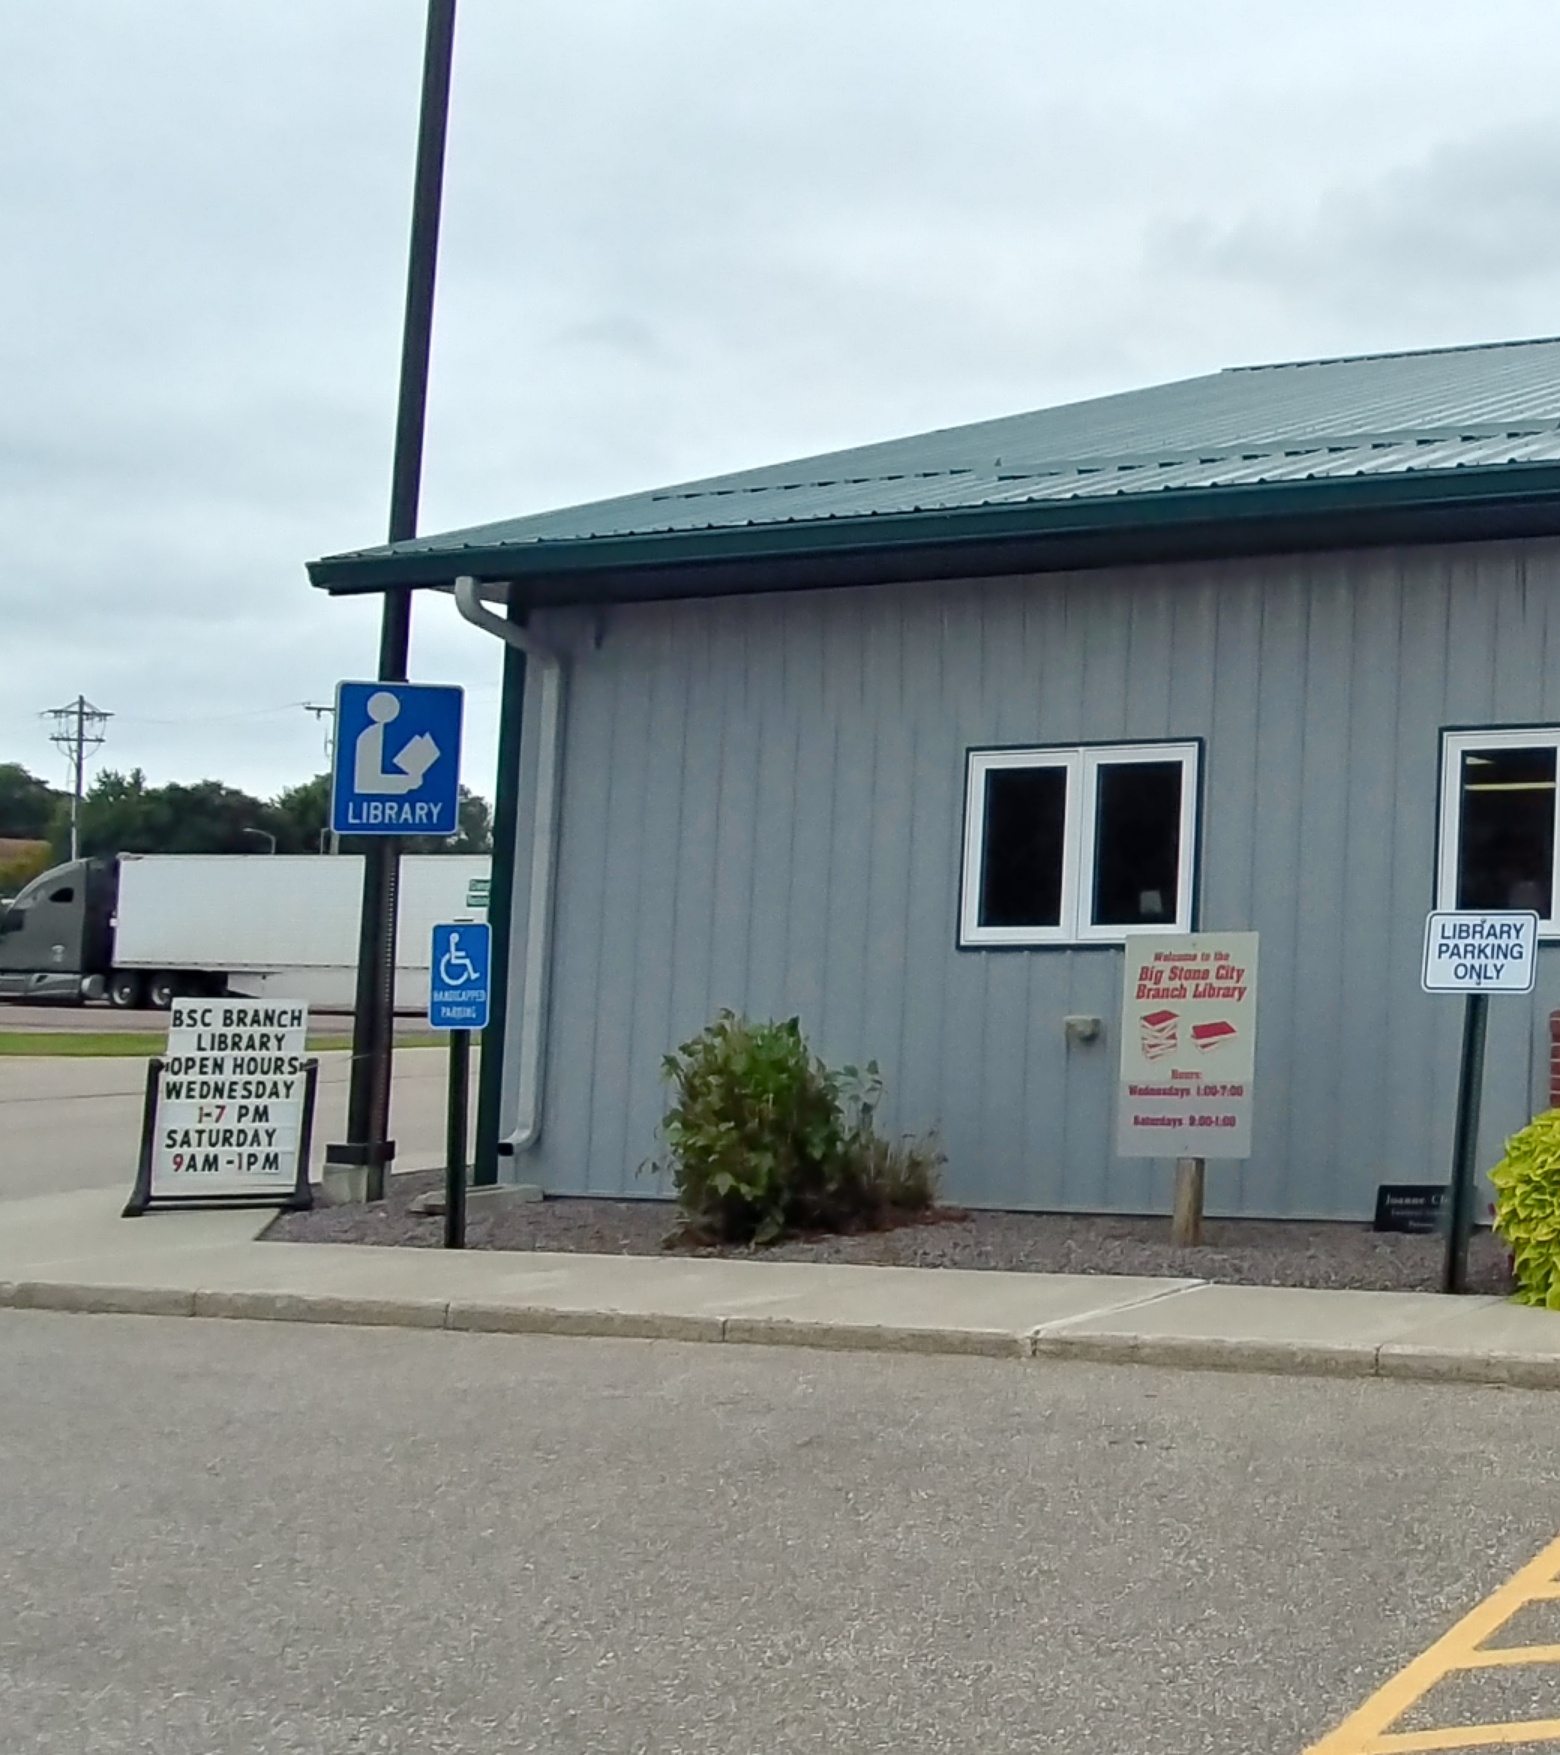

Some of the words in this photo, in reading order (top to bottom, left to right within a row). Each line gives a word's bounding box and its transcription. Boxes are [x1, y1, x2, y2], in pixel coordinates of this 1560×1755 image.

[347, 801, 442, 824] LIBRARY
[1440, 923, 1525, 940] LIBRARY
[1153, 951, 1198, 962] Welcome
[1201, 951, 1211, 962] to
[1214, 950, 1230, 961] the
[1437, 942, 1525, 960] PARKING
[1138, 965, 1164, 985] Big
[1168, 965, 1211, 981] Stone
[1214, 964, 1245, 983] City
[1454, 962, 1505, 980] ONLY
[433, 989, 486, 1002] HANDICAPPED
[1136, 983, 1187, 1000] Branch
[1192, 982, 1247, 1002] Library
[172, 1008, 213, 1028] BSC
[222, 1008, 303, 1028] BRANCH
[440, 1005, 477, 1018] PARKING
[196, 1033, 286, 1051] LIBRARY
[170, 1056, 225, 1076] OPEN
[232, 1056, 299, 1075] HOURS
[165, 1080, 295, 1100] WEDNESDAY
[198, 1105, 226, 1124] 1-7
[237, 1105, 270, 1123] PM
[165, 1128, 277, 1149] SATURDAY
